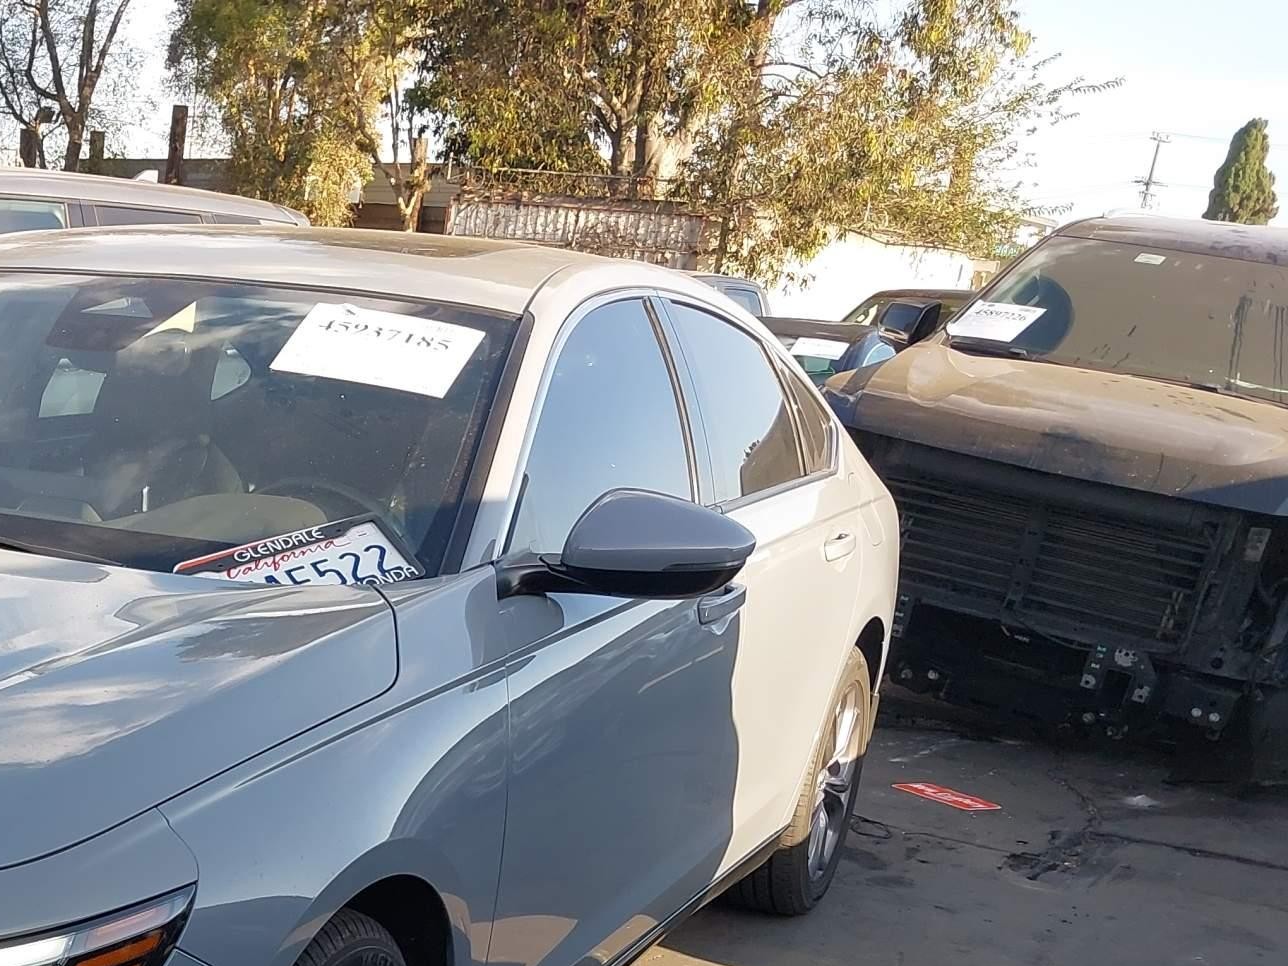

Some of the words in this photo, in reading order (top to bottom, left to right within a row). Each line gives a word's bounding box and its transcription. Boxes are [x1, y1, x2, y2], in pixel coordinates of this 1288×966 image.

[318, 318, 453, 351] 45937185
[226, 537, 350, 580] California
[233, 527, 325, 562] GLENDALE
[357, 565, 419, 585] ONDA
